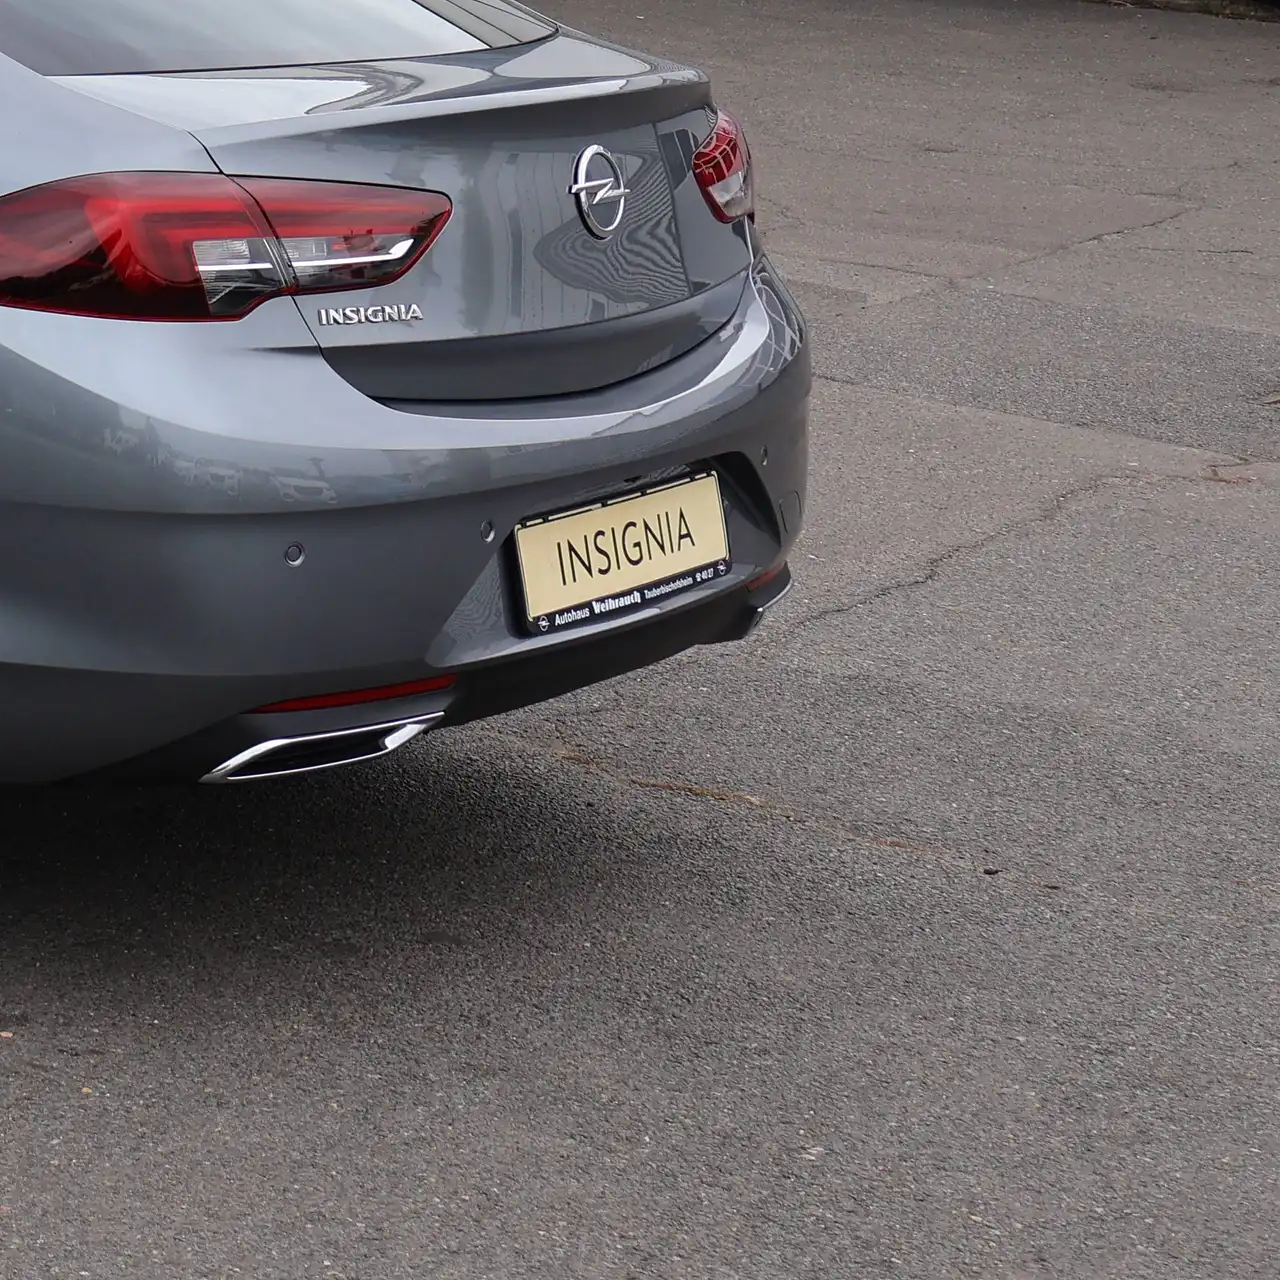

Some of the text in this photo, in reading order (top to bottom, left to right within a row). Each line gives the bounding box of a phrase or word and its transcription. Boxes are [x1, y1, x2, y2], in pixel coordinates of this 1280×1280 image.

[319, 303, 424, 326] INSIGNIA
[557, 506, 696, 586] INSIGNIA
[554, 608, 590, 627] Autohaus
[592, 590, 641, 615] Weihrauch
[644, 577, 693, 598] Tauberbischofsheim
